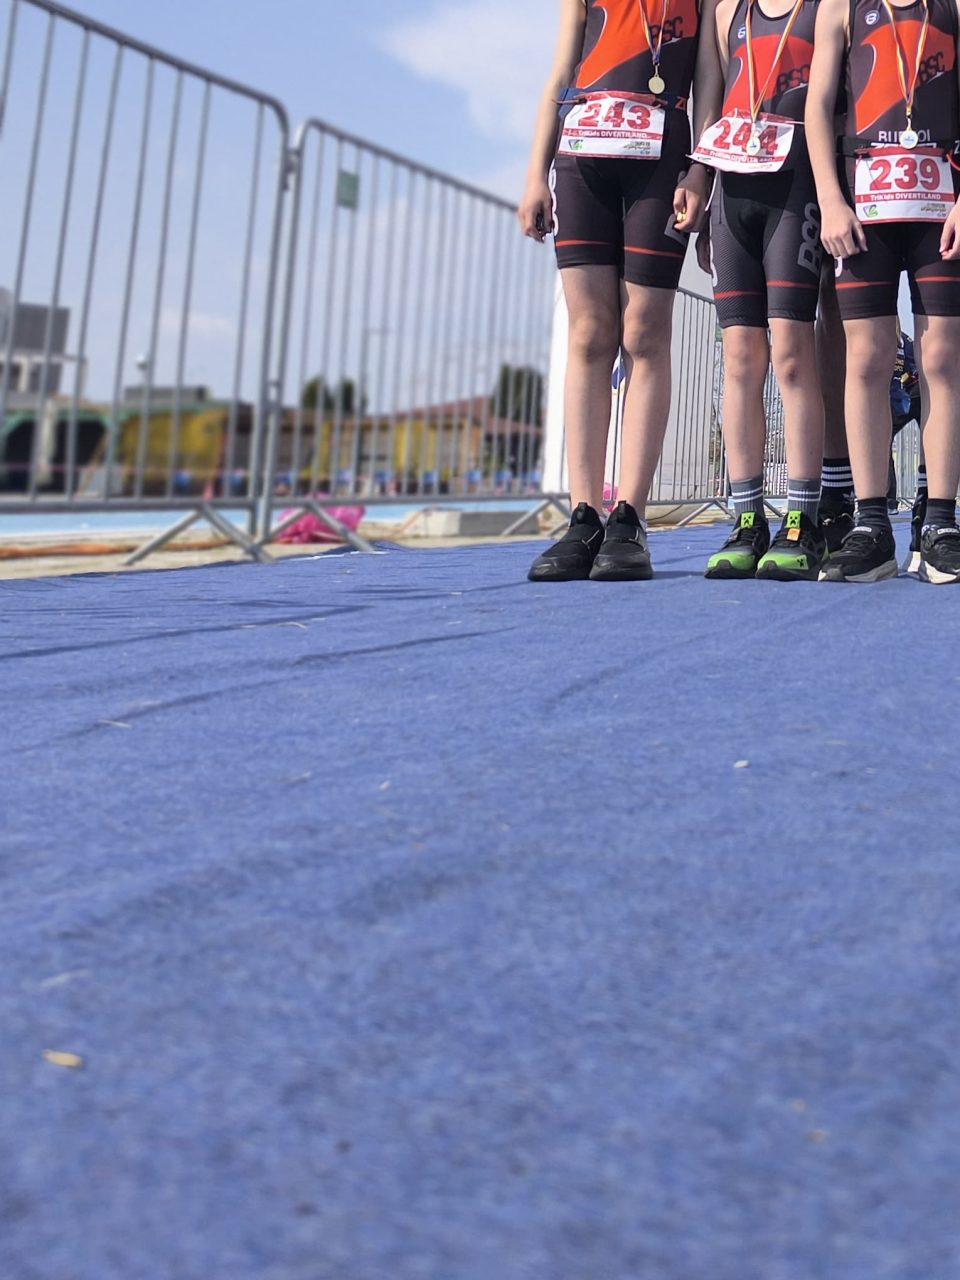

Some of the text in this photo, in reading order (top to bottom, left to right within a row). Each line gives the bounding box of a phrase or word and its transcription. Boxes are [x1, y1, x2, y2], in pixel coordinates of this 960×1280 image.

[578, 101, 651, 130] 243
[713, 120, 778, 155] 244
[869, 157, 941, 191] 239
[895, 192, 941, 200] DIVERTILAND
